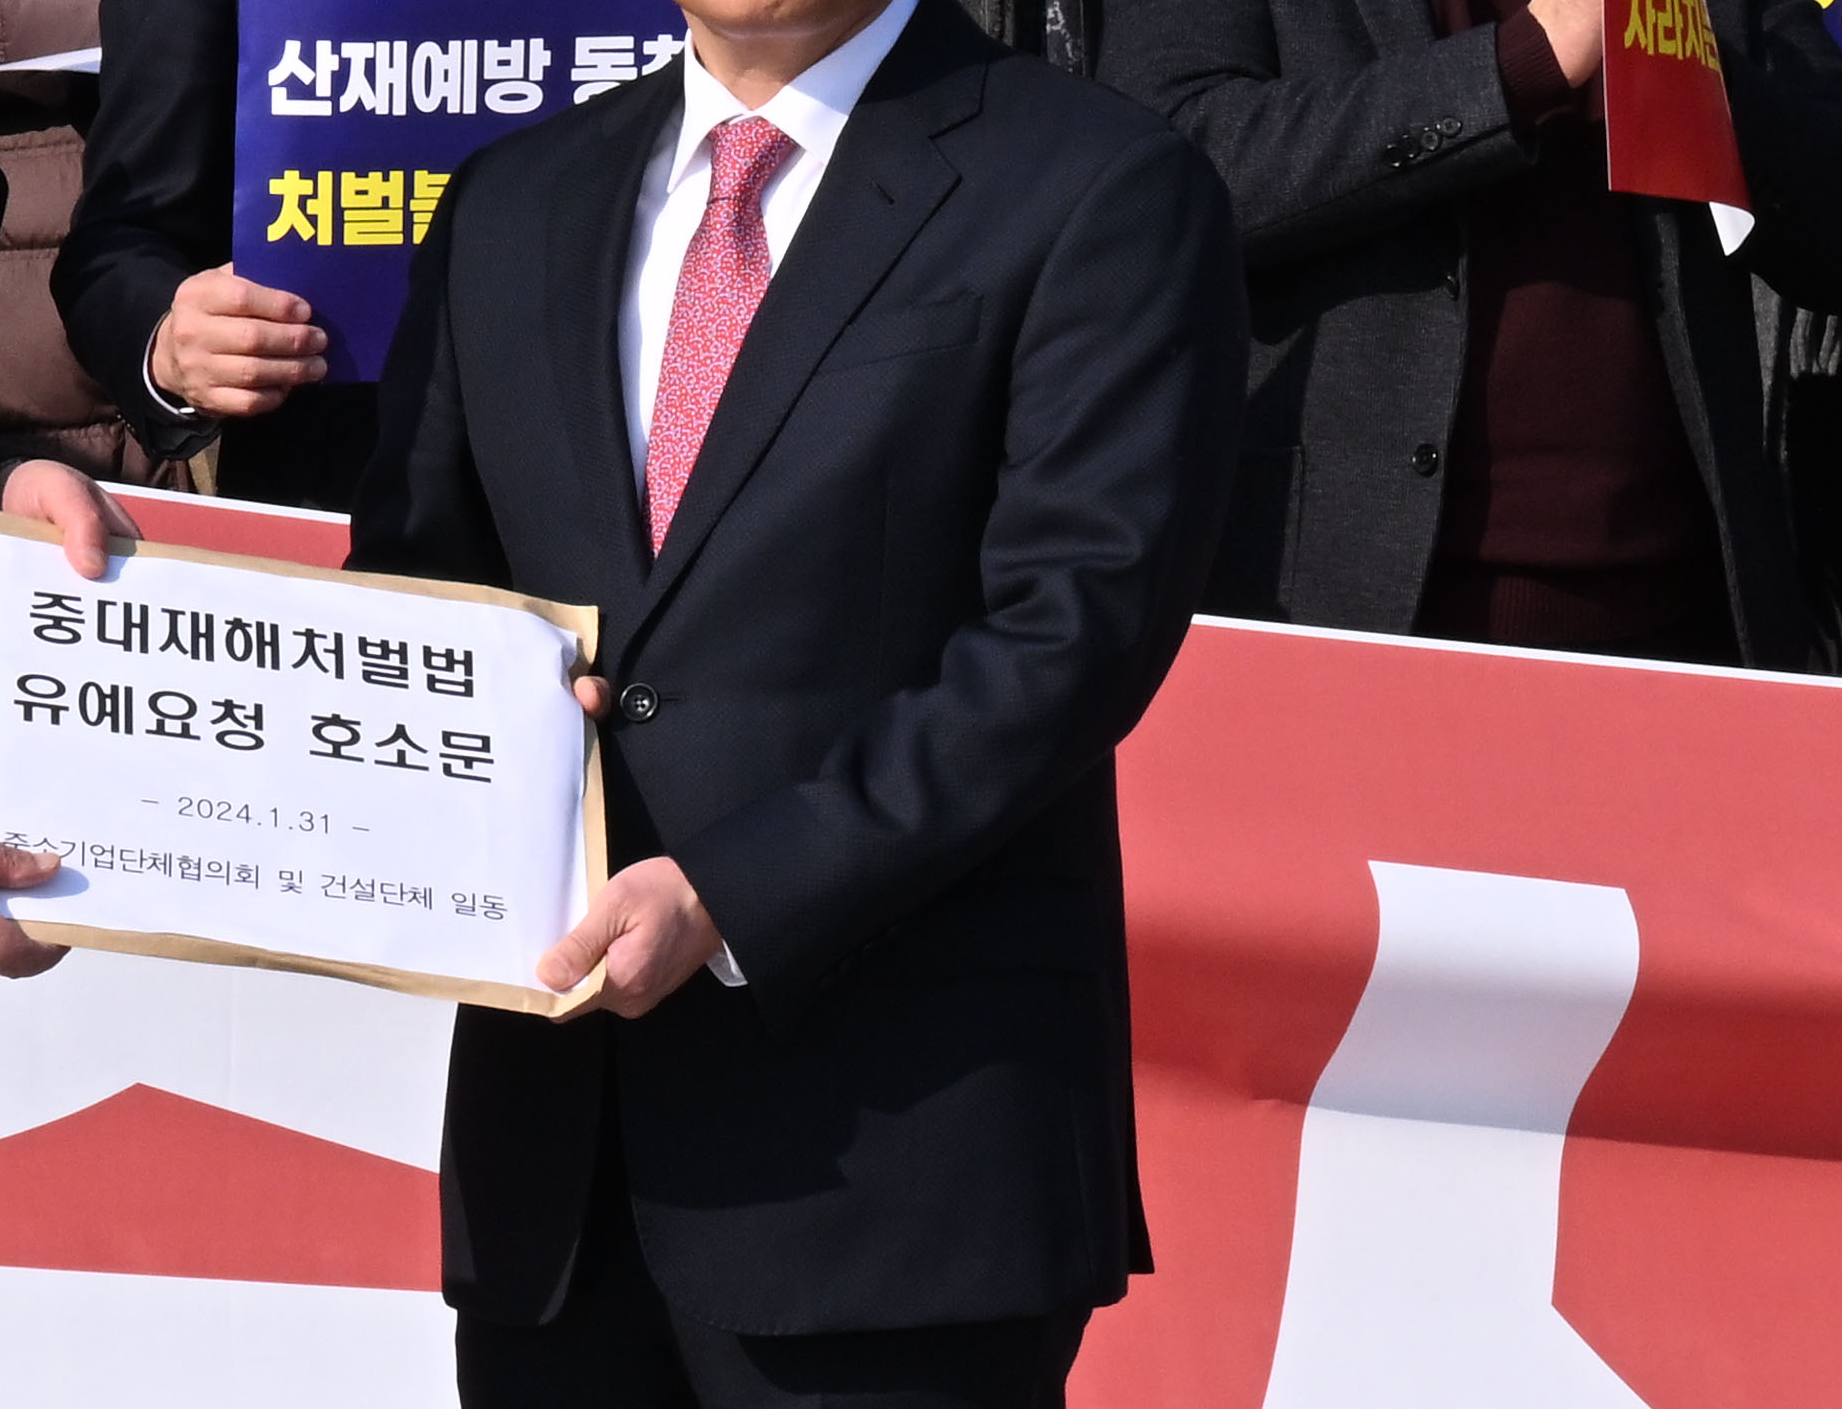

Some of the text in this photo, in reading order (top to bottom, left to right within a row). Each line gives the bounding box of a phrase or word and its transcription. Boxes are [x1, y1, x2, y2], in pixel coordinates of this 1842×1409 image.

[267, 37, 552, 117] 산재예방
[29, 591, 475, 698] 중대재해처벌법
[13, 673, 495, 783] 유예요청 호소문
[176, 794, 332, 836] 2024.1.31
[277, 868, 305, 894] 및
[319, 872, 435, 911] 건설단체
[450, 889, 510, 922] 일동
